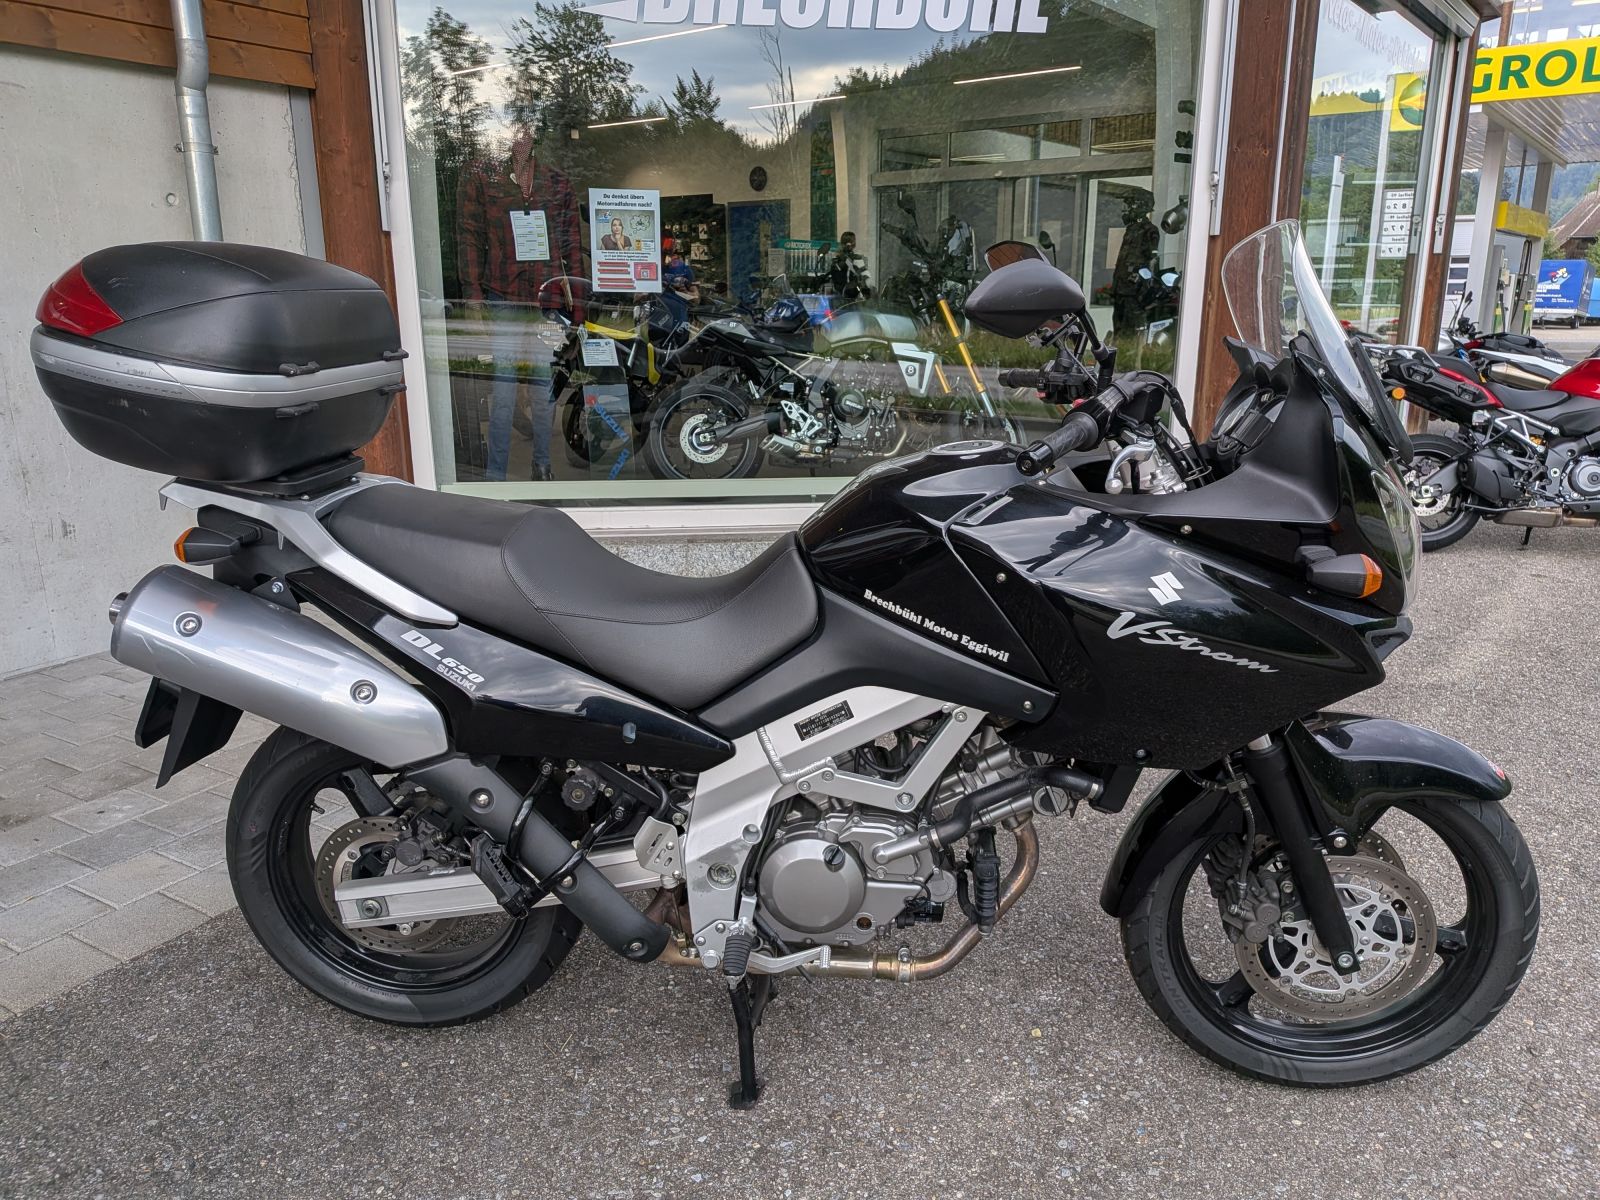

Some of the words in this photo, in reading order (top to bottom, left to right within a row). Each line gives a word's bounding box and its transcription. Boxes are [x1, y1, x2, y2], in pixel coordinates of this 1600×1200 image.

[594, 402, 631, 442] SUZUKI
[863, 588, 923, 625] Brechbühl
[923, 617, 960, 642] Motos
[960, 634, 1010, 663] Eggiwil
[1106, 611, 1280, 673] V-Strom
[436, 663, 477, 692] SUZUKI
